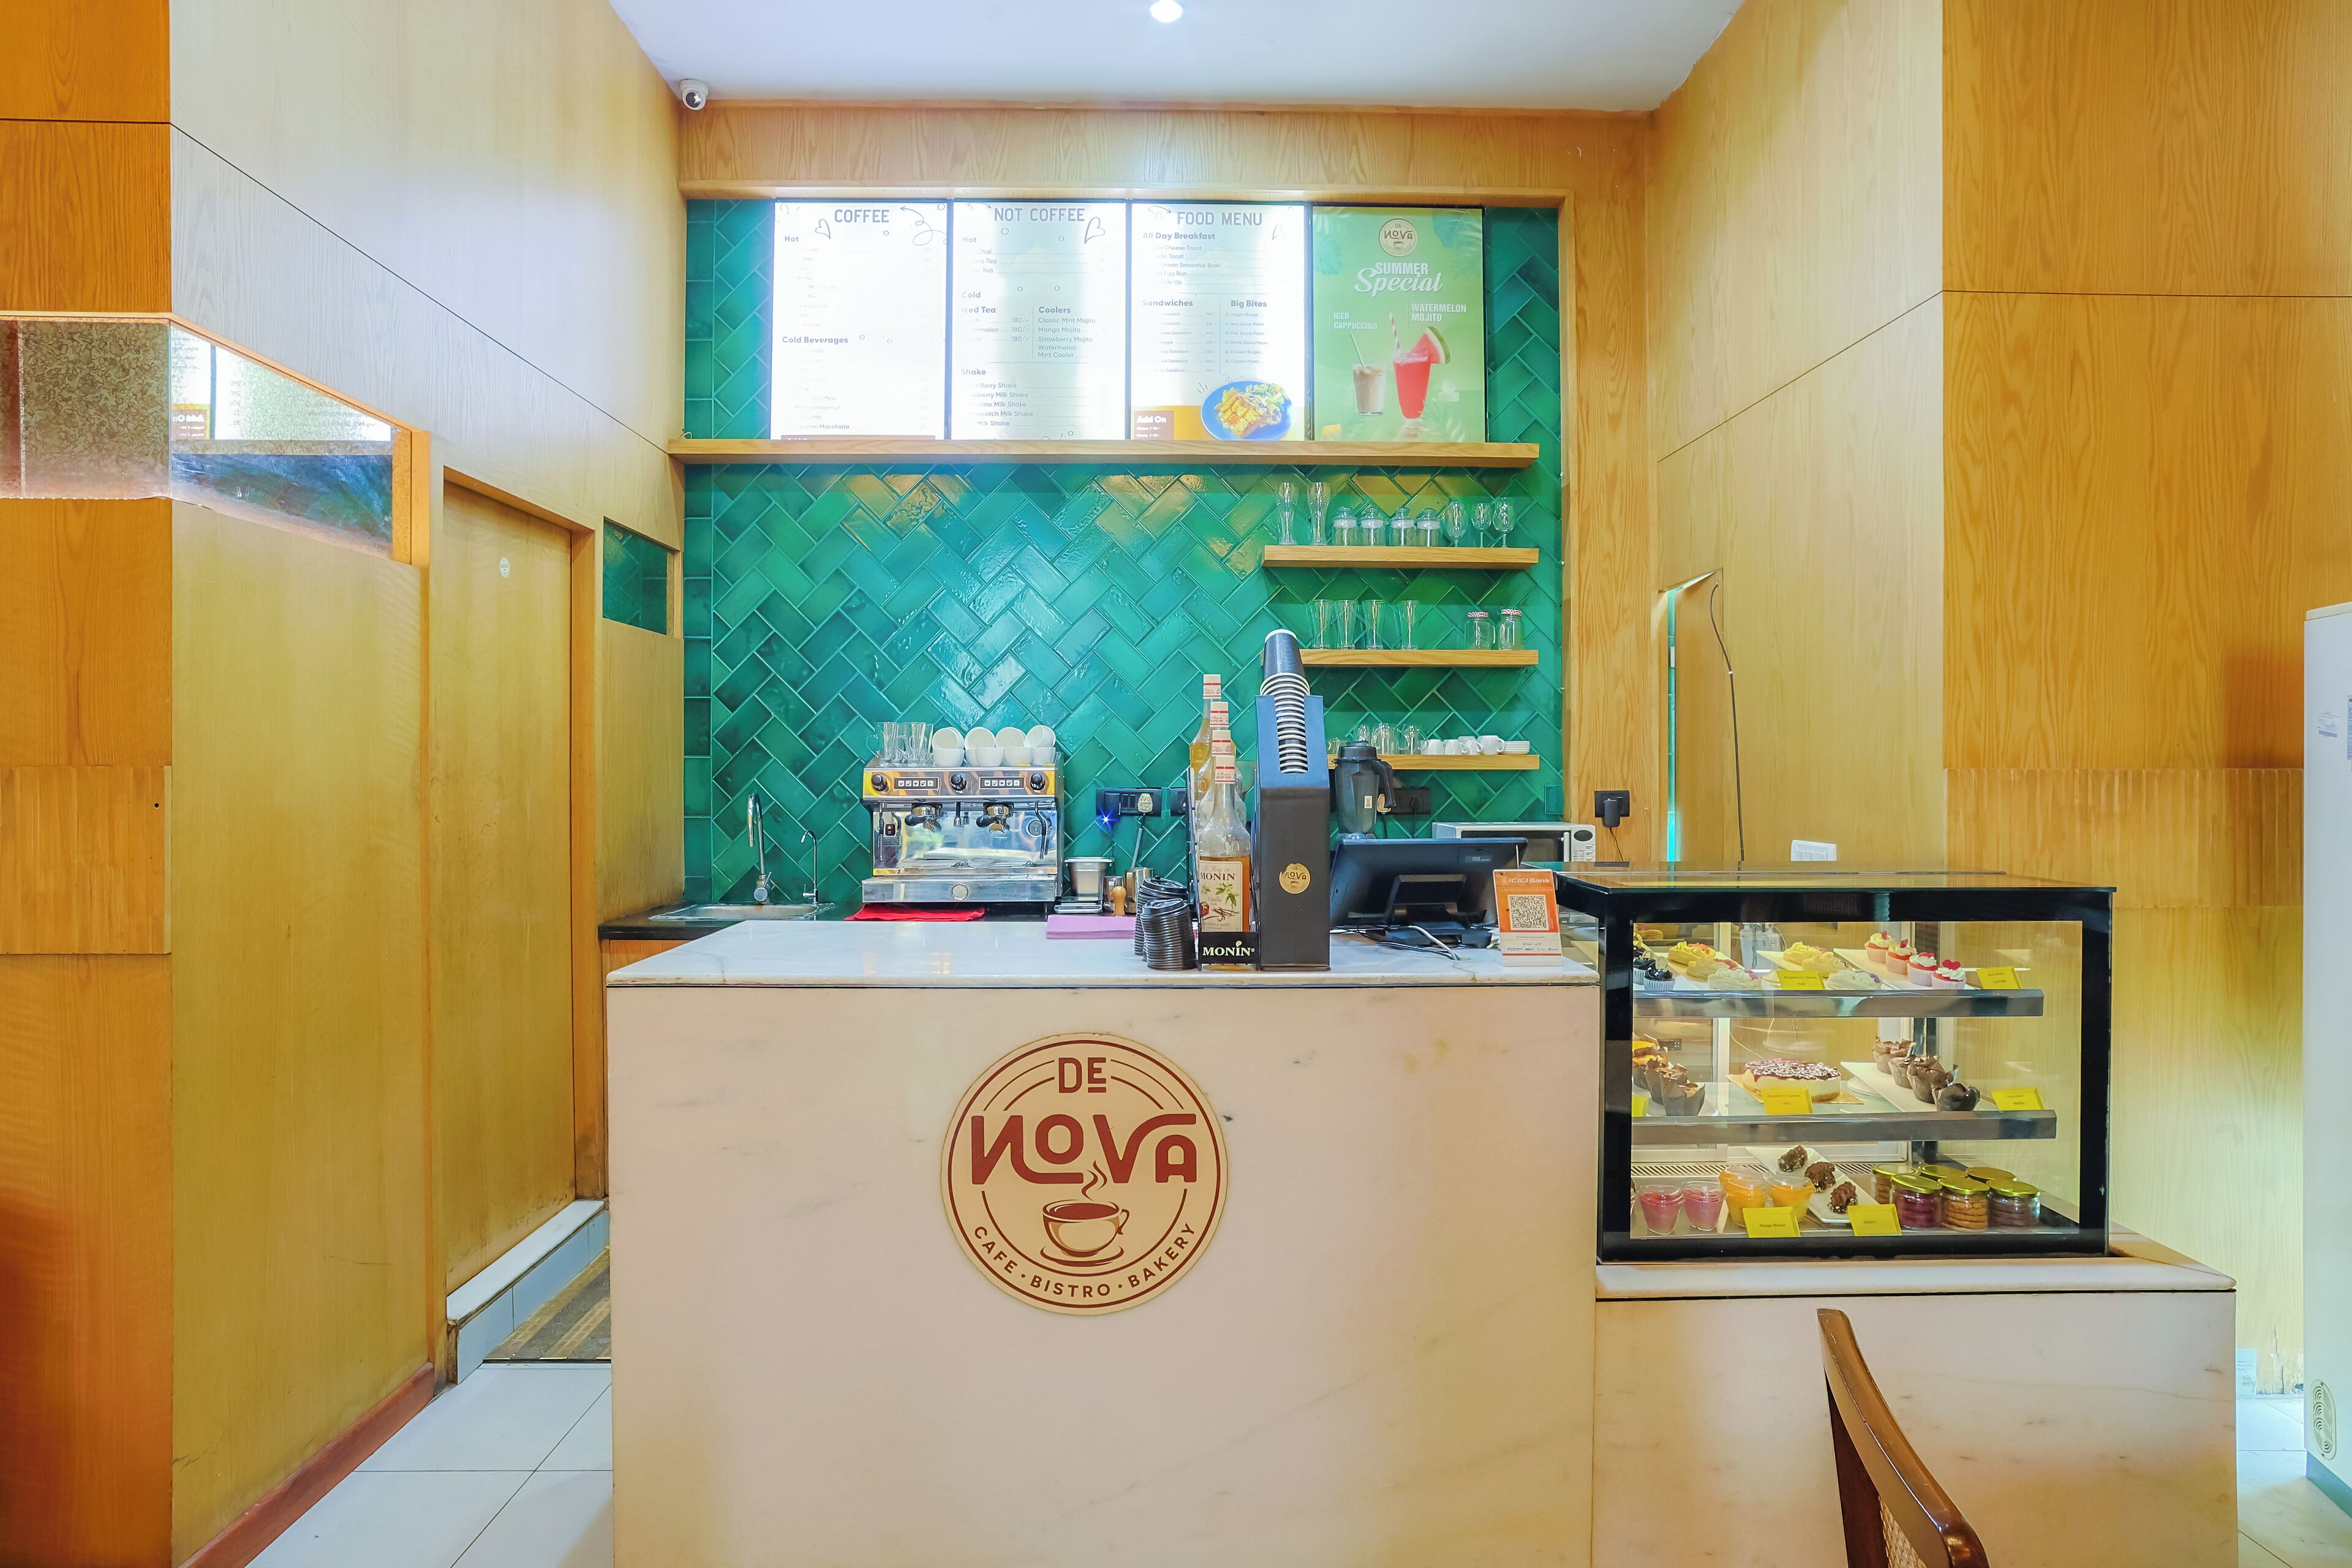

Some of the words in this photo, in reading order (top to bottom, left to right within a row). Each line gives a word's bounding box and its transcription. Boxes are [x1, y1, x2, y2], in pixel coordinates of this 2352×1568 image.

[834, 209, 889, 223] COFFEE
[994, 208, 1023, 221] NOT
[1030, 208, 1085, 221] COFFEE
[1177, 211, 1215, 225] FOOD
[1221, 213, 1262, 225] MENU
[1155, 232, 1172, 241] Day
[1384, 230, 1412, 239] NOVA
[1375, 262, 1428, 275] SUMMER
[1354, 268, 1444, 298] Special
[1231, 300, 1245, 309] Big
[1411, 303, 1467, 312] WATERMELON
[1411, 313, 1442, 322] MOJITO
[804, 336, 848, 345] Beverages
[1058, 1057, 1107, 1093] DE
[971, 1113, 1197, 1185] NOVA
[974, 1226, 1018, 1273] CAFE
[1030, 1274, 1110, 1298] BISTRO
[1127, 1223, 1196, 1288] BAKERY
